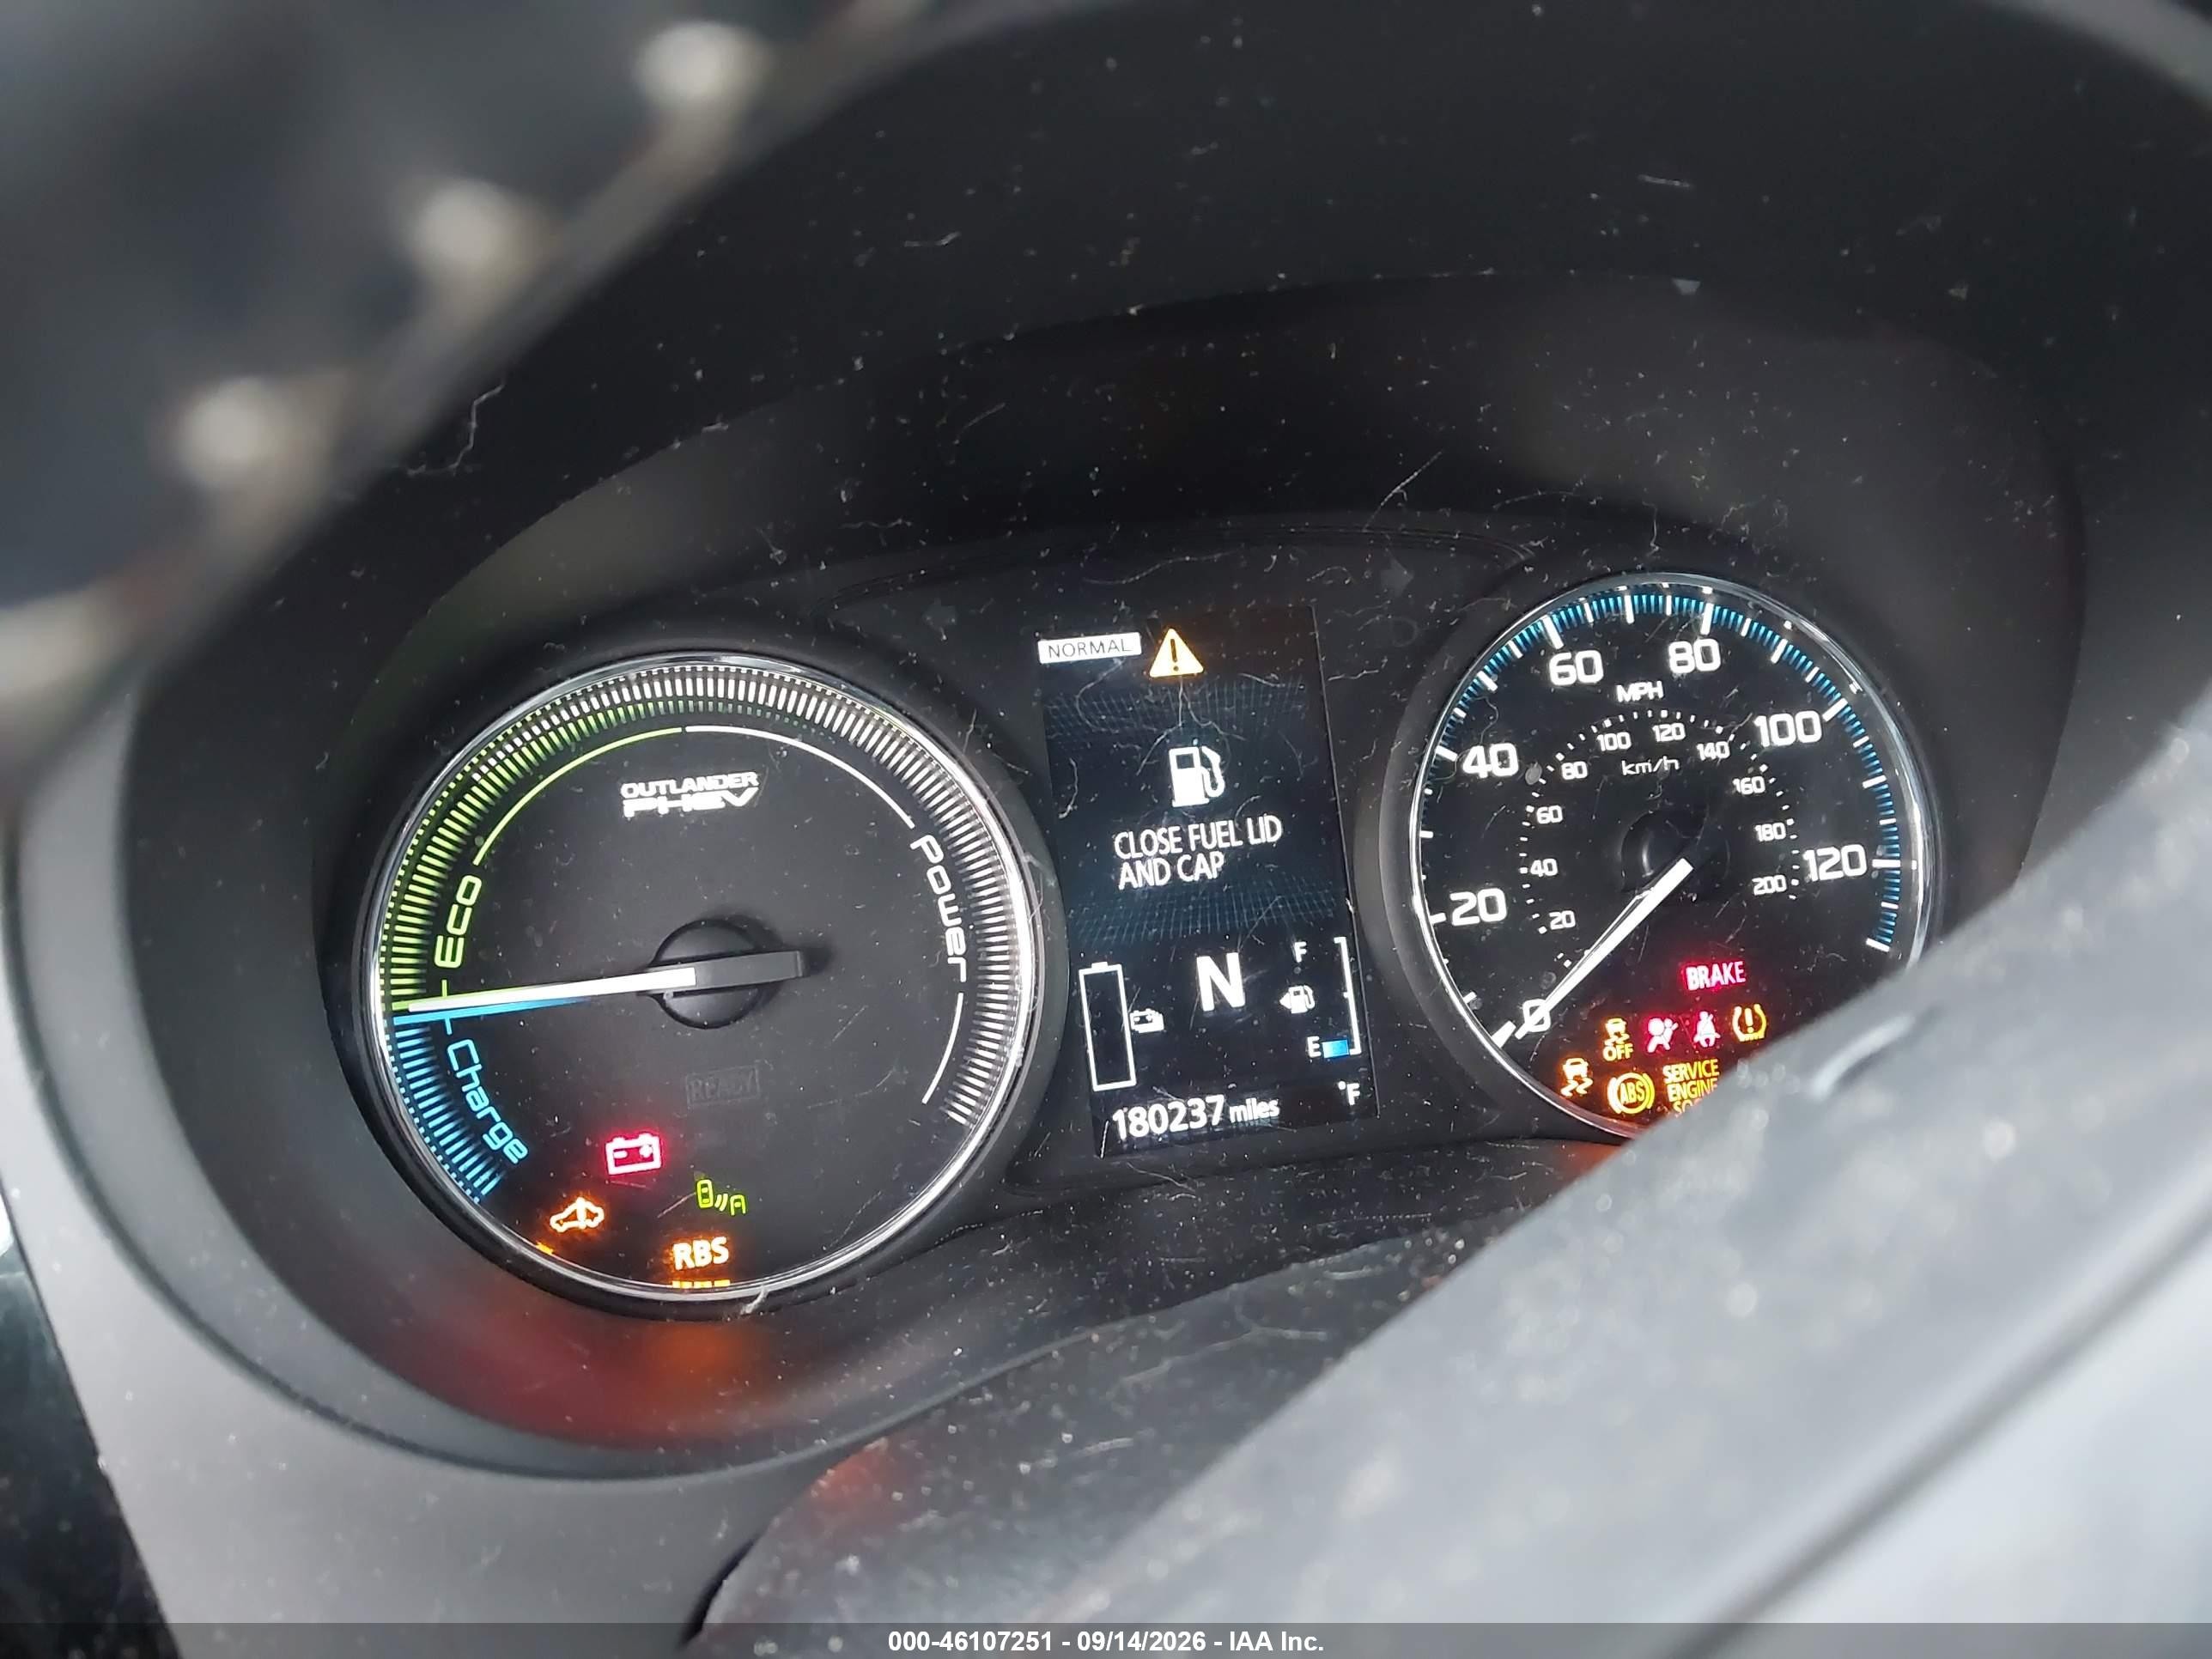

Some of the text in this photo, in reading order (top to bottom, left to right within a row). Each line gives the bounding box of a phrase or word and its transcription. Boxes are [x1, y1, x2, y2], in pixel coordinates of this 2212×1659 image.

[1048, 638, 1132, 659] NORMAL
[1668, 638, 1722, 675] 80
[1548, 650, 1605, 687] 60
[1616, 681, 1664, 701] MPH
[1596, 731, 1632, 751] 100
[1651, 722, 1686, 742] 120
[1753, 710, 1823, 747] 100
[1462, 743, 1520, 778] 40
[1696, 740, 1730, 761] 140
[1561, 761, 1588, 780] 80
[1620, 755, 1680, 776] km/h
[621, 771, 760, 799] OUTLANDER
[1733, 775, 1766, 795] 160
[623, 787, 759, 819] PHEV
[1535, 804, 1563, 824] 60
[1115, 813, 1283, 860] CLOSE FUEL LID
[1754, 822, 1786, 842] 180
[1118, 853, 1224, 890] AND CAP
[1530, 858, 1559, 878] 40
[1802, 844, 1867, 883] 120
[1753, 874, 1786, 895] 200
[910, 835, 968, 983] Power
[1449, 888, 1507, 927] 20
[1549, 910, 1575, 930] 20
[435, 874, 482, 969] Eco
[1294, 942, 1307, 963] F
[1196, 952, 1246, 1012] N
[1686, 962, 1746, 990] BRAKE
[1522, 999, 1551, 1032] 0
[1308, 1037, 1320, 1057] E
[1603, 1043, 1633, 1061] OFF
[1663, 1059, 1719, 1085] SERVICE
[447, 1038, 529, 1164] Charge
[1620, 1080, 1646, 1104] ABS
[1112, 1096, 1280, 1139] 180237 miles
[673, 1237, 729, 1270] RBS
